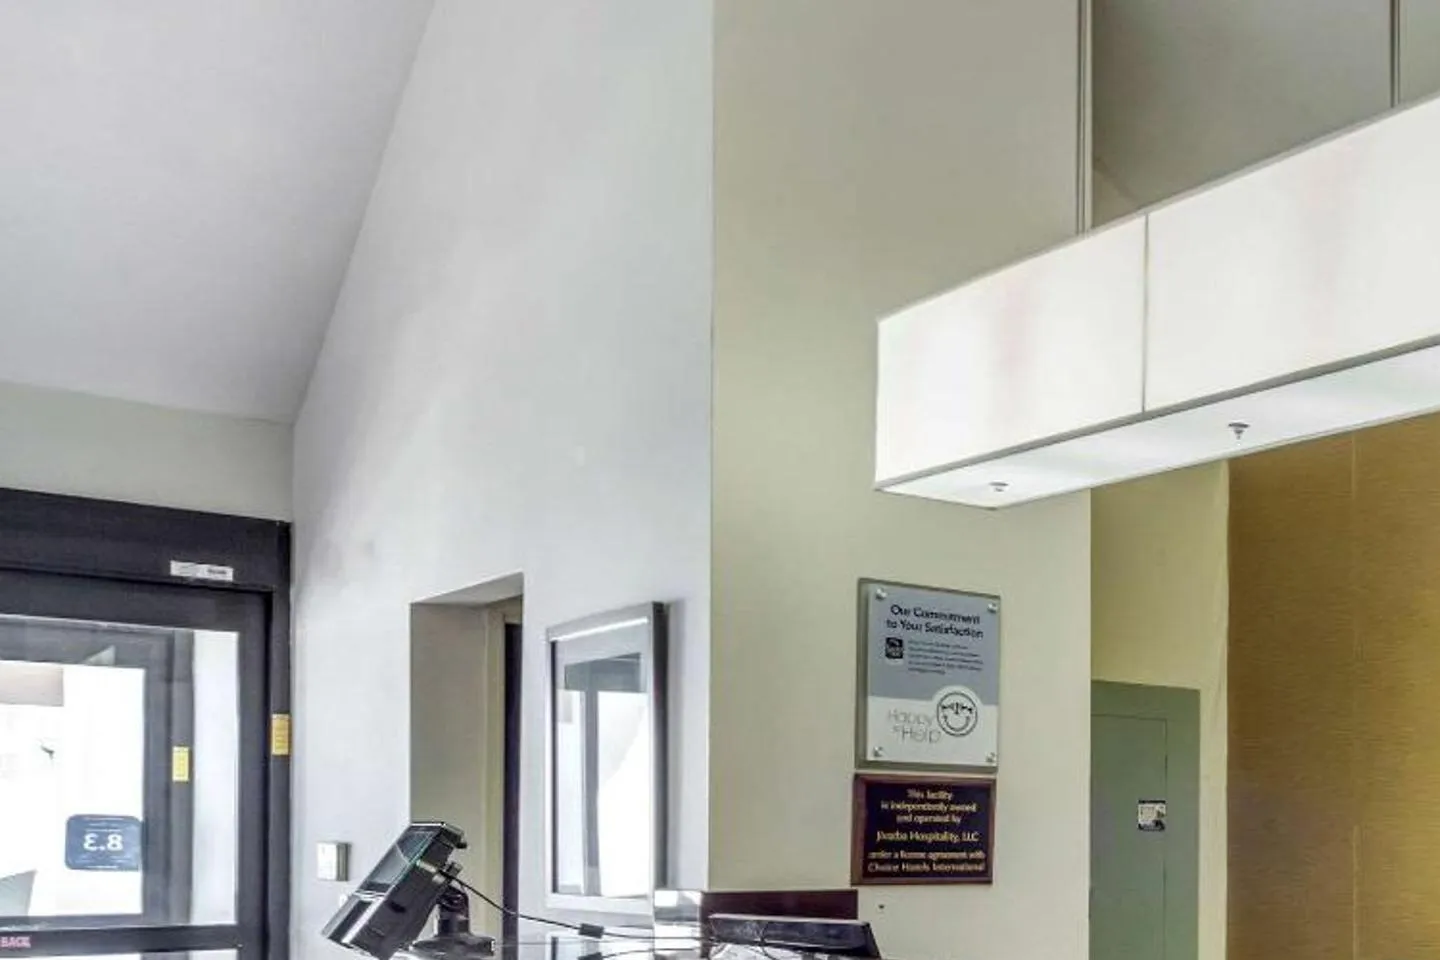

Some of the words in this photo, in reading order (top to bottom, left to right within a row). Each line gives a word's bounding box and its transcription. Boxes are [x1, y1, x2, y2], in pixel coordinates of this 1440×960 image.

[890, 604, 910, 617] Our
[914, 607, 980, 625] Commitment
[886, 619, 897, 629] to
[900, 620, 922, 632] Your
[925, 622, 984, 639] Satisfaction
[888, 708, 935, 726] Happy
[902, 725, 941, 744] Help
[907, 788, 924, 799] This
[927, 789, 952, 800] facility
[890, 801, 948, 812] independently
[896, 814, 912, 823] and
[914, 814, 950, 824] operated
[962, 832, 980, 841] LLC
[867, 862, 899, 872] Choice
[901, 862, 931, 872] Hotels
[932, 862, 986, 872] International
